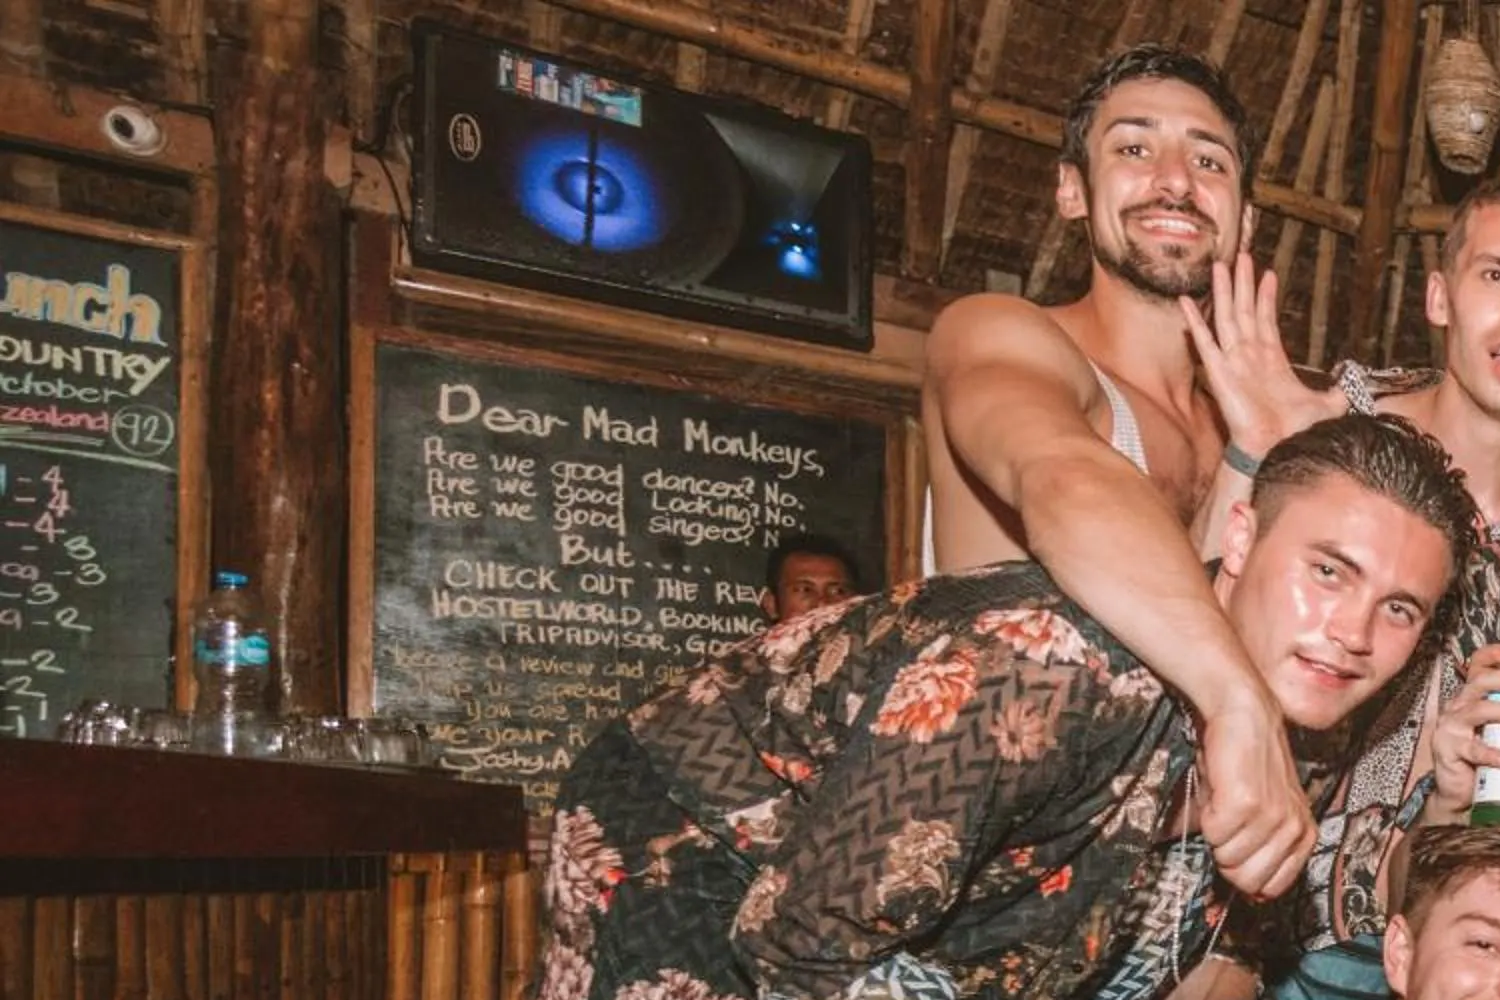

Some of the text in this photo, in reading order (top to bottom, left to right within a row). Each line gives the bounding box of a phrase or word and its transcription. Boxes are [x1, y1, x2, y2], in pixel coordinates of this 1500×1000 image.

[0, 264, 167, 347] unch
[0, 335, 171, 396] OUNTRY
[0, 372, 129, 403] ctober
[438, 383, 569, 437] Dear
[583, 405, 658, 447] Mad
[41, 465, 64, 493] 4
[424, 436, 478, 469] Are
[489, 454, 535, 476] we
[551, 461, 623, 487] good
[765, 481, 804, 510] No.
[428, 468, 479, 495] Are
[490, 478, 538, 497] we
[554, 484, 624, 508] good
[765, 507, 806, 532] No.
[33, 511, 66, 543] 4
[430, 495, 481, 518] Are
[490, 501, 536, 521] we
[553, 507, 626, 537] good
[764, 530, 779, 547] N
[75, 563, 106, 585] 3
[444, 559, 768, 606] CHECK OUT THE REV
[26, 583, 60, 605] 3
[56, 607, 93, 631] 2
[31, 649, 65, 674] 2
[5, 675, 47, 697] 2
